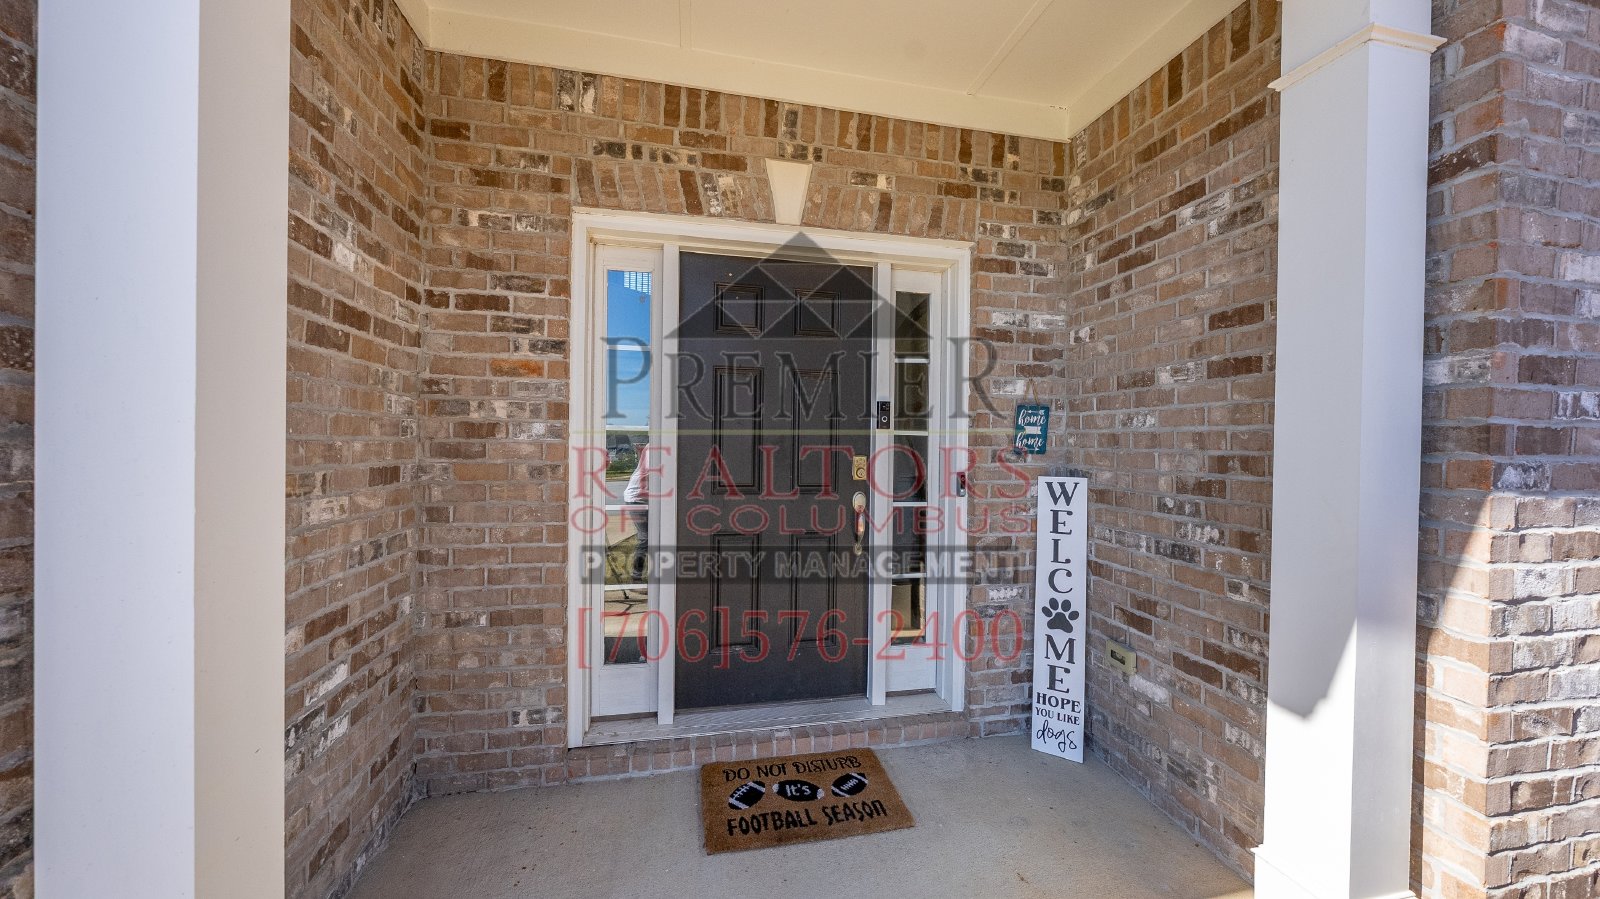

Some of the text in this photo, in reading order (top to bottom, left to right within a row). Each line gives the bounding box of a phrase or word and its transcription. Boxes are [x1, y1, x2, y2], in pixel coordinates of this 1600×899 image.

[1018, 409, 1047, 426] home
[1016, 431, 1045, 448] home
[1042, 481, 1080, 694] WELCME
[1036, 692, 1081, 714] HOPE
[1035, 706, 1080, 726] YOU LIKE
[1036, 719, 1077, 753] dogs
[722, 756, 862, 782] DO NOT DISTURB
[785, 783, 811, 797] It's
[727, 799, 888, 837] FOOTBALL SEASON
